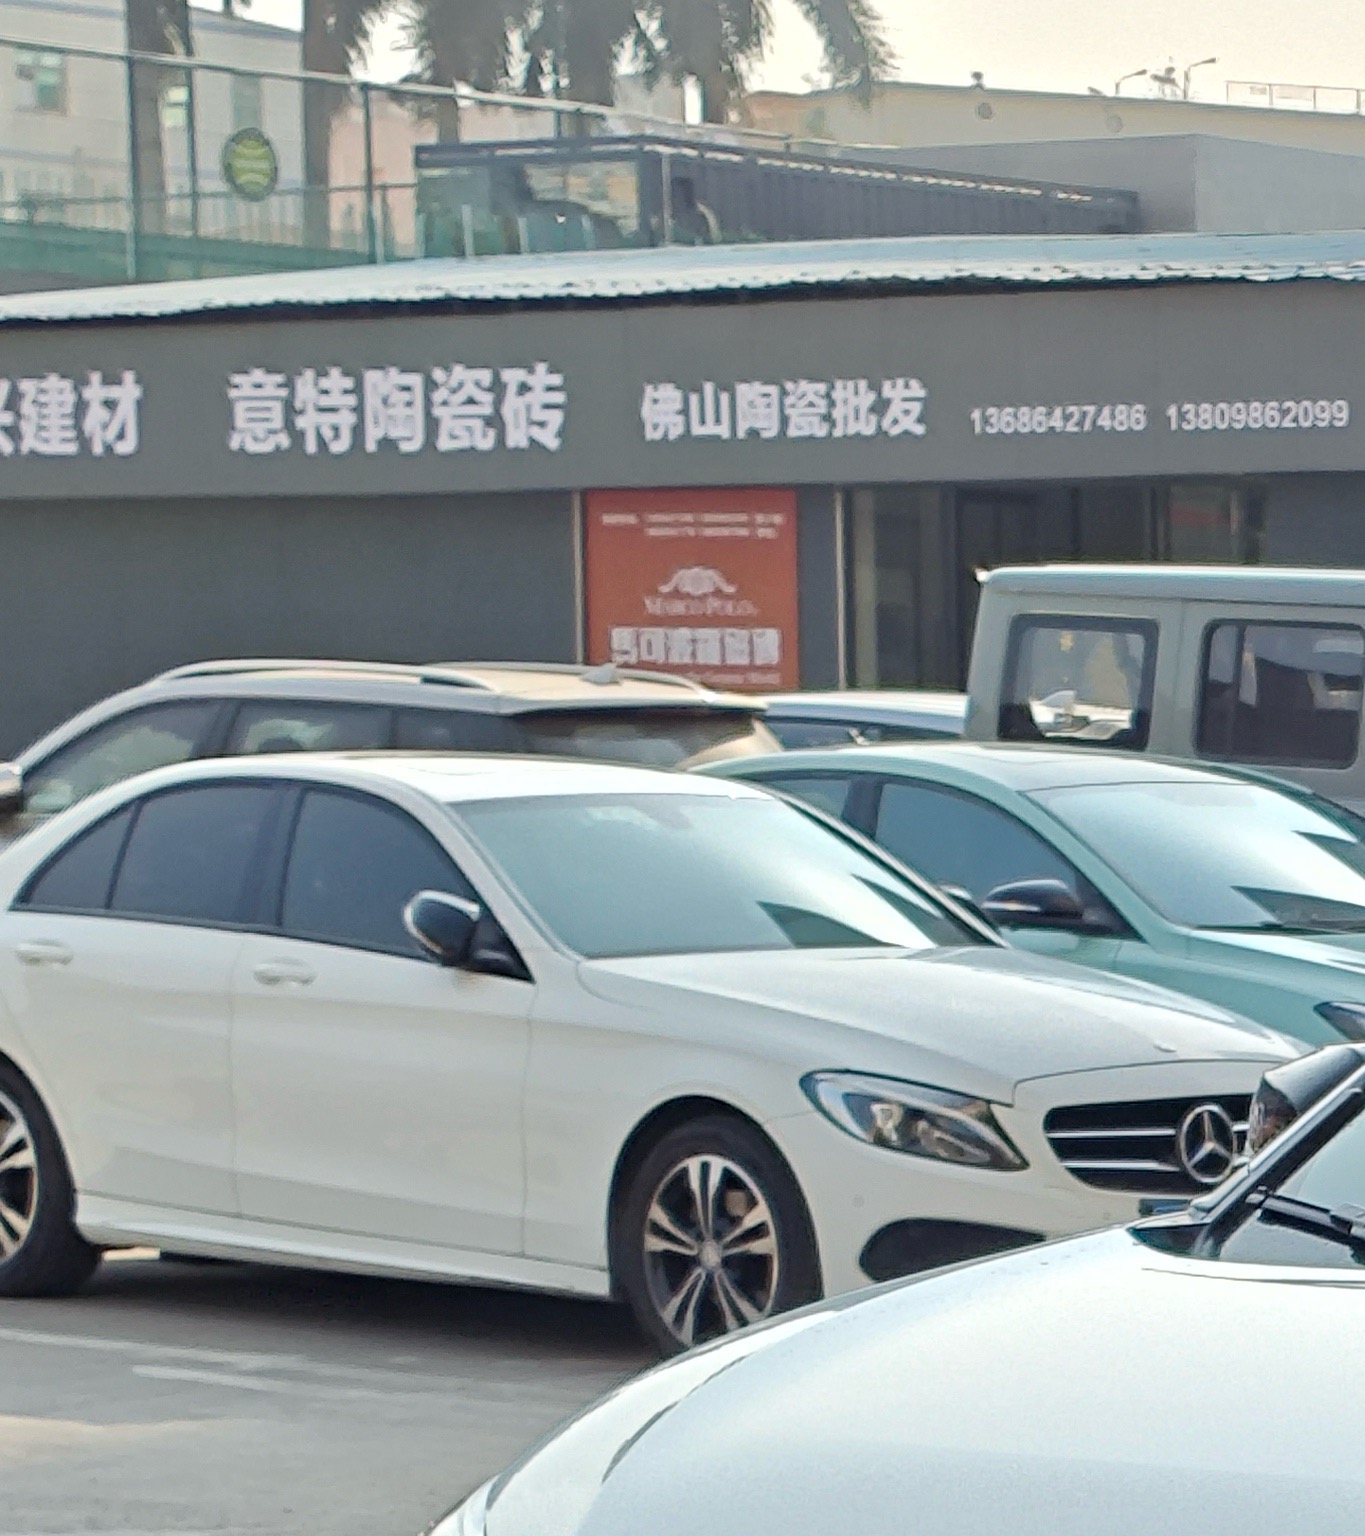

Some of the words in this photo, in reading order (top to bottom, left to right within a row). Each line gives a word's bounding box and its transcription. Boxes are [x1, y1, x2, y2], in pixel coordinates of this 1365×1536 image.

[0, 370, 144, 457] 建材
[226, 366, 568, 456] 意特陶瓷砖
[640, 377, 928, 442] 佛山陶瓷批发
[969, 403, 1148, 436] 13686427486
[1166, 399, 1350, 432] 13809862099
